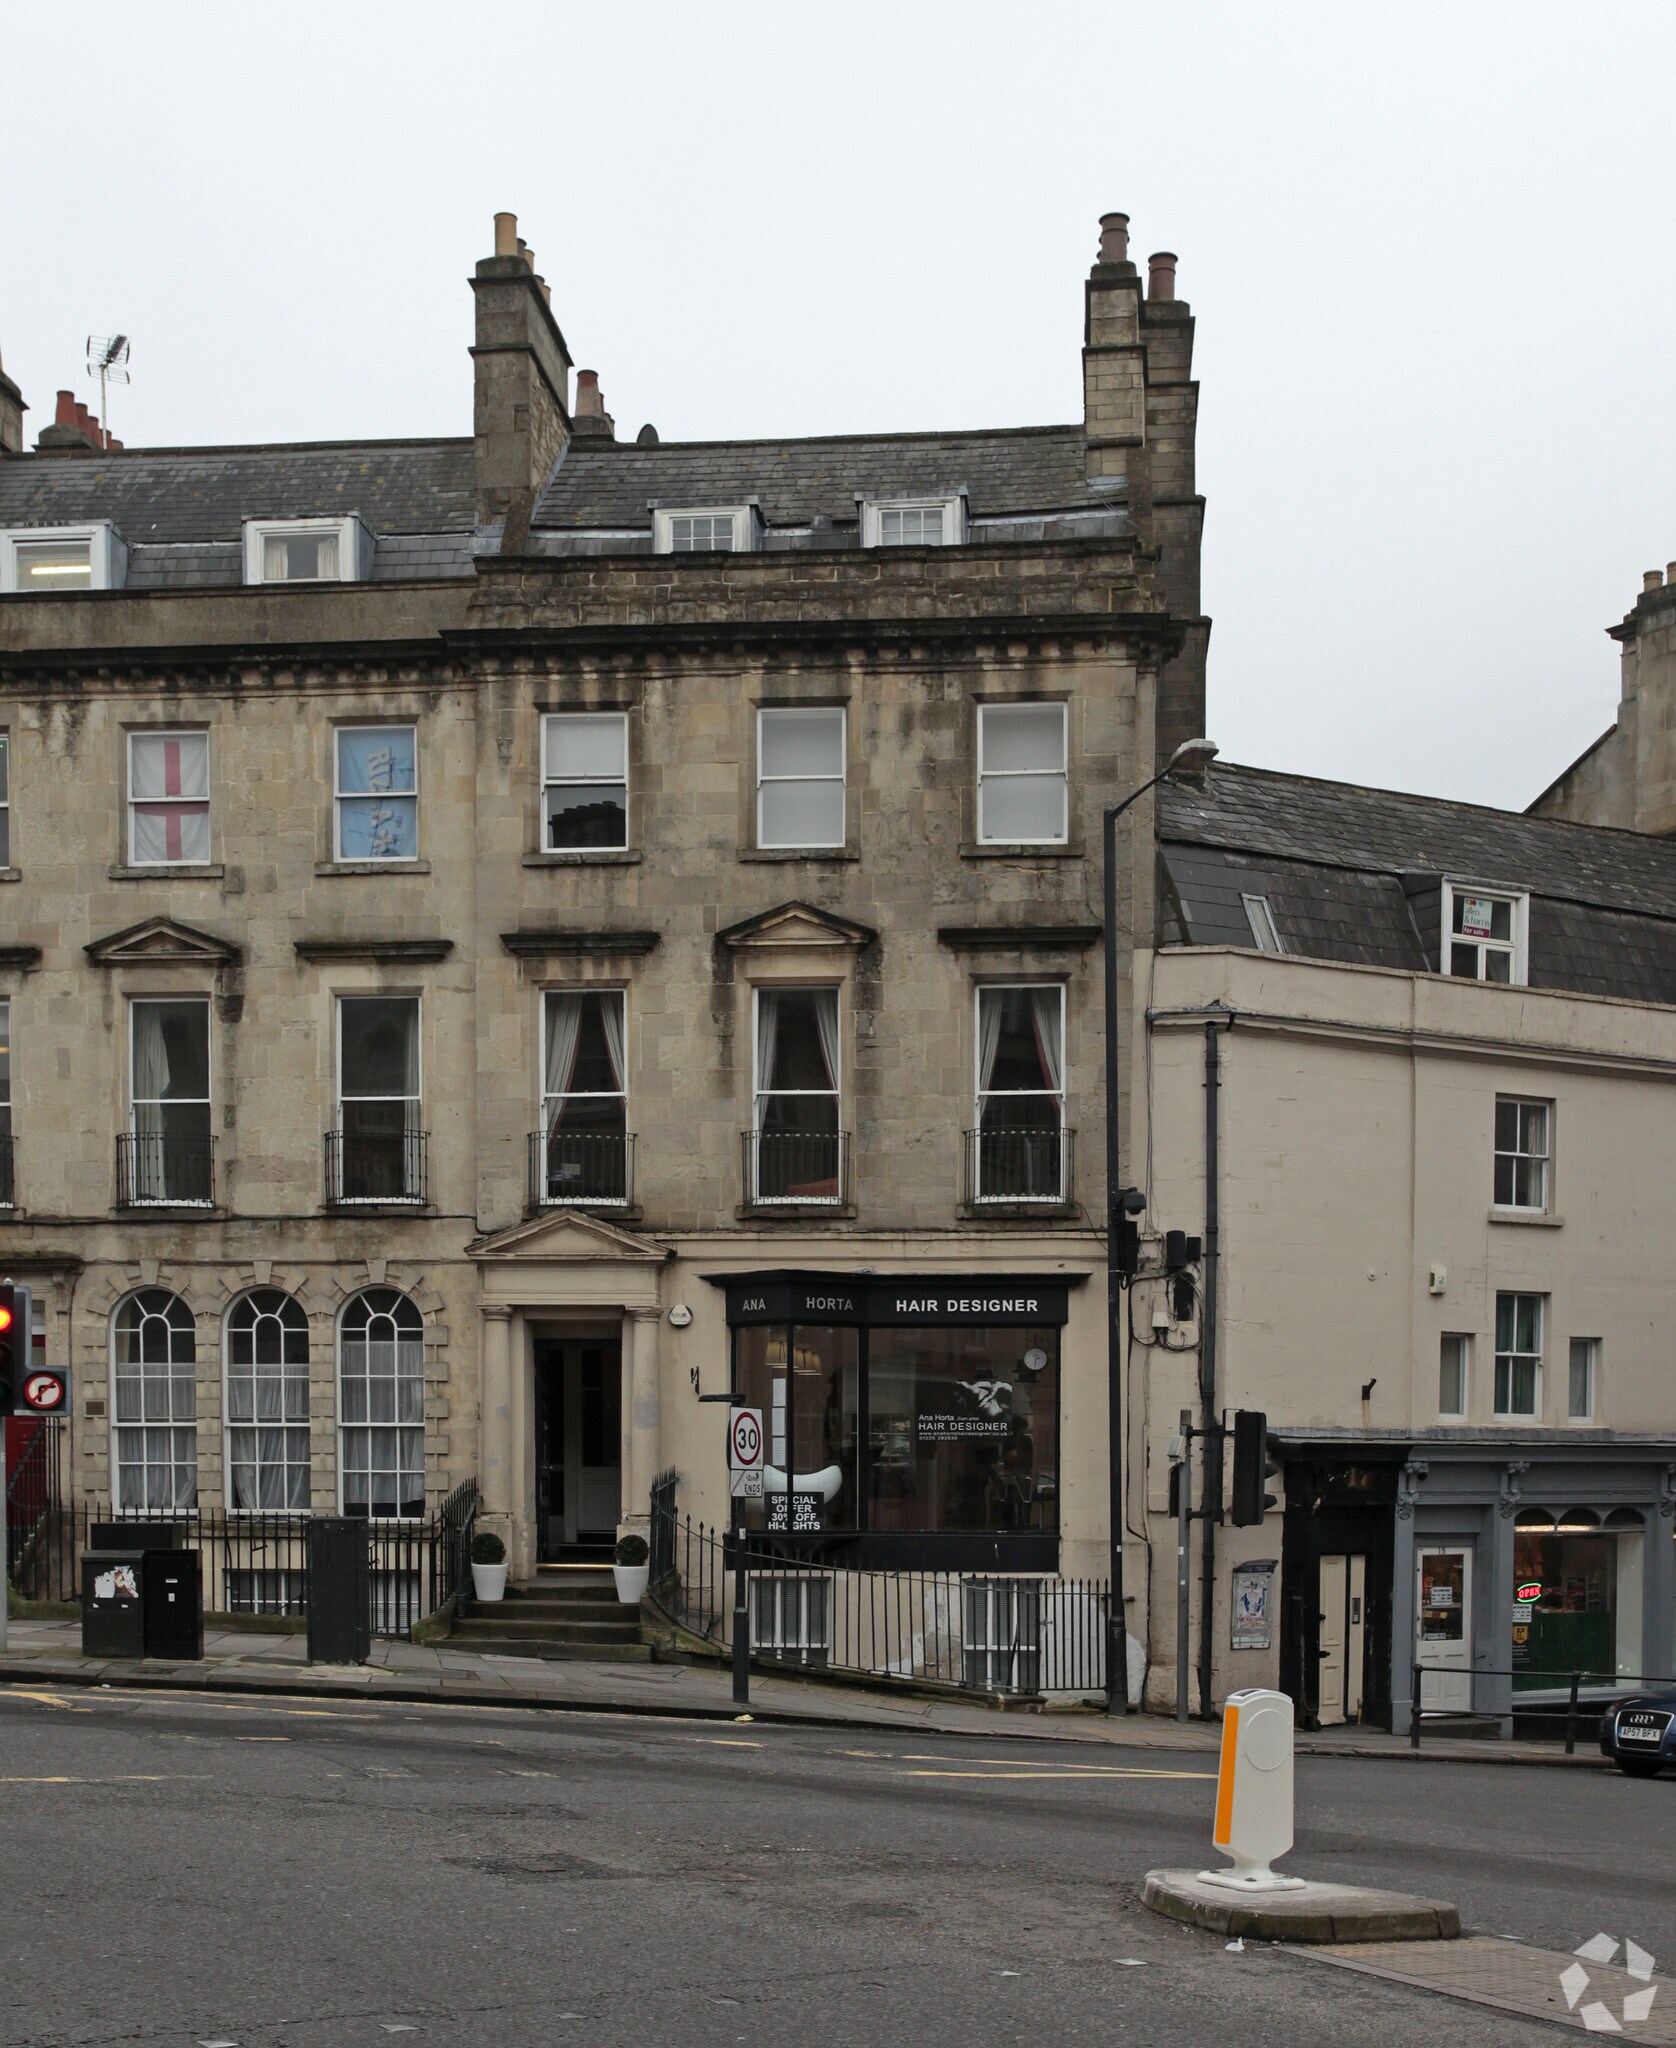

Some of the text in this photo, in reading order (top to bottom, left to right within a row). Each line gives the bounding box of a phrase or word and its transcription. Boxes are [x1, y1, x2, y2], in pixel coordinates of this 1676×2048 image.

[1474, 928, 1484, 936] sale
[742, 1299, 766, 1311] ANA
[806, 1297, 853, 1311] HORTA
[896, 1299, 1038, 1312] HAIR DESIGNER
[918, 1422, 1008, 1431] HAIR DESIGNER
[738, 1428, 758, 1450] 30
[744, 1484, 760, 1493] ENDS
[795, 1512, 817, 1521] OFF
[768, 1521, 821, 1530] HI-LGHTS
[1518, 1586, 1541, 1599] OPEN
